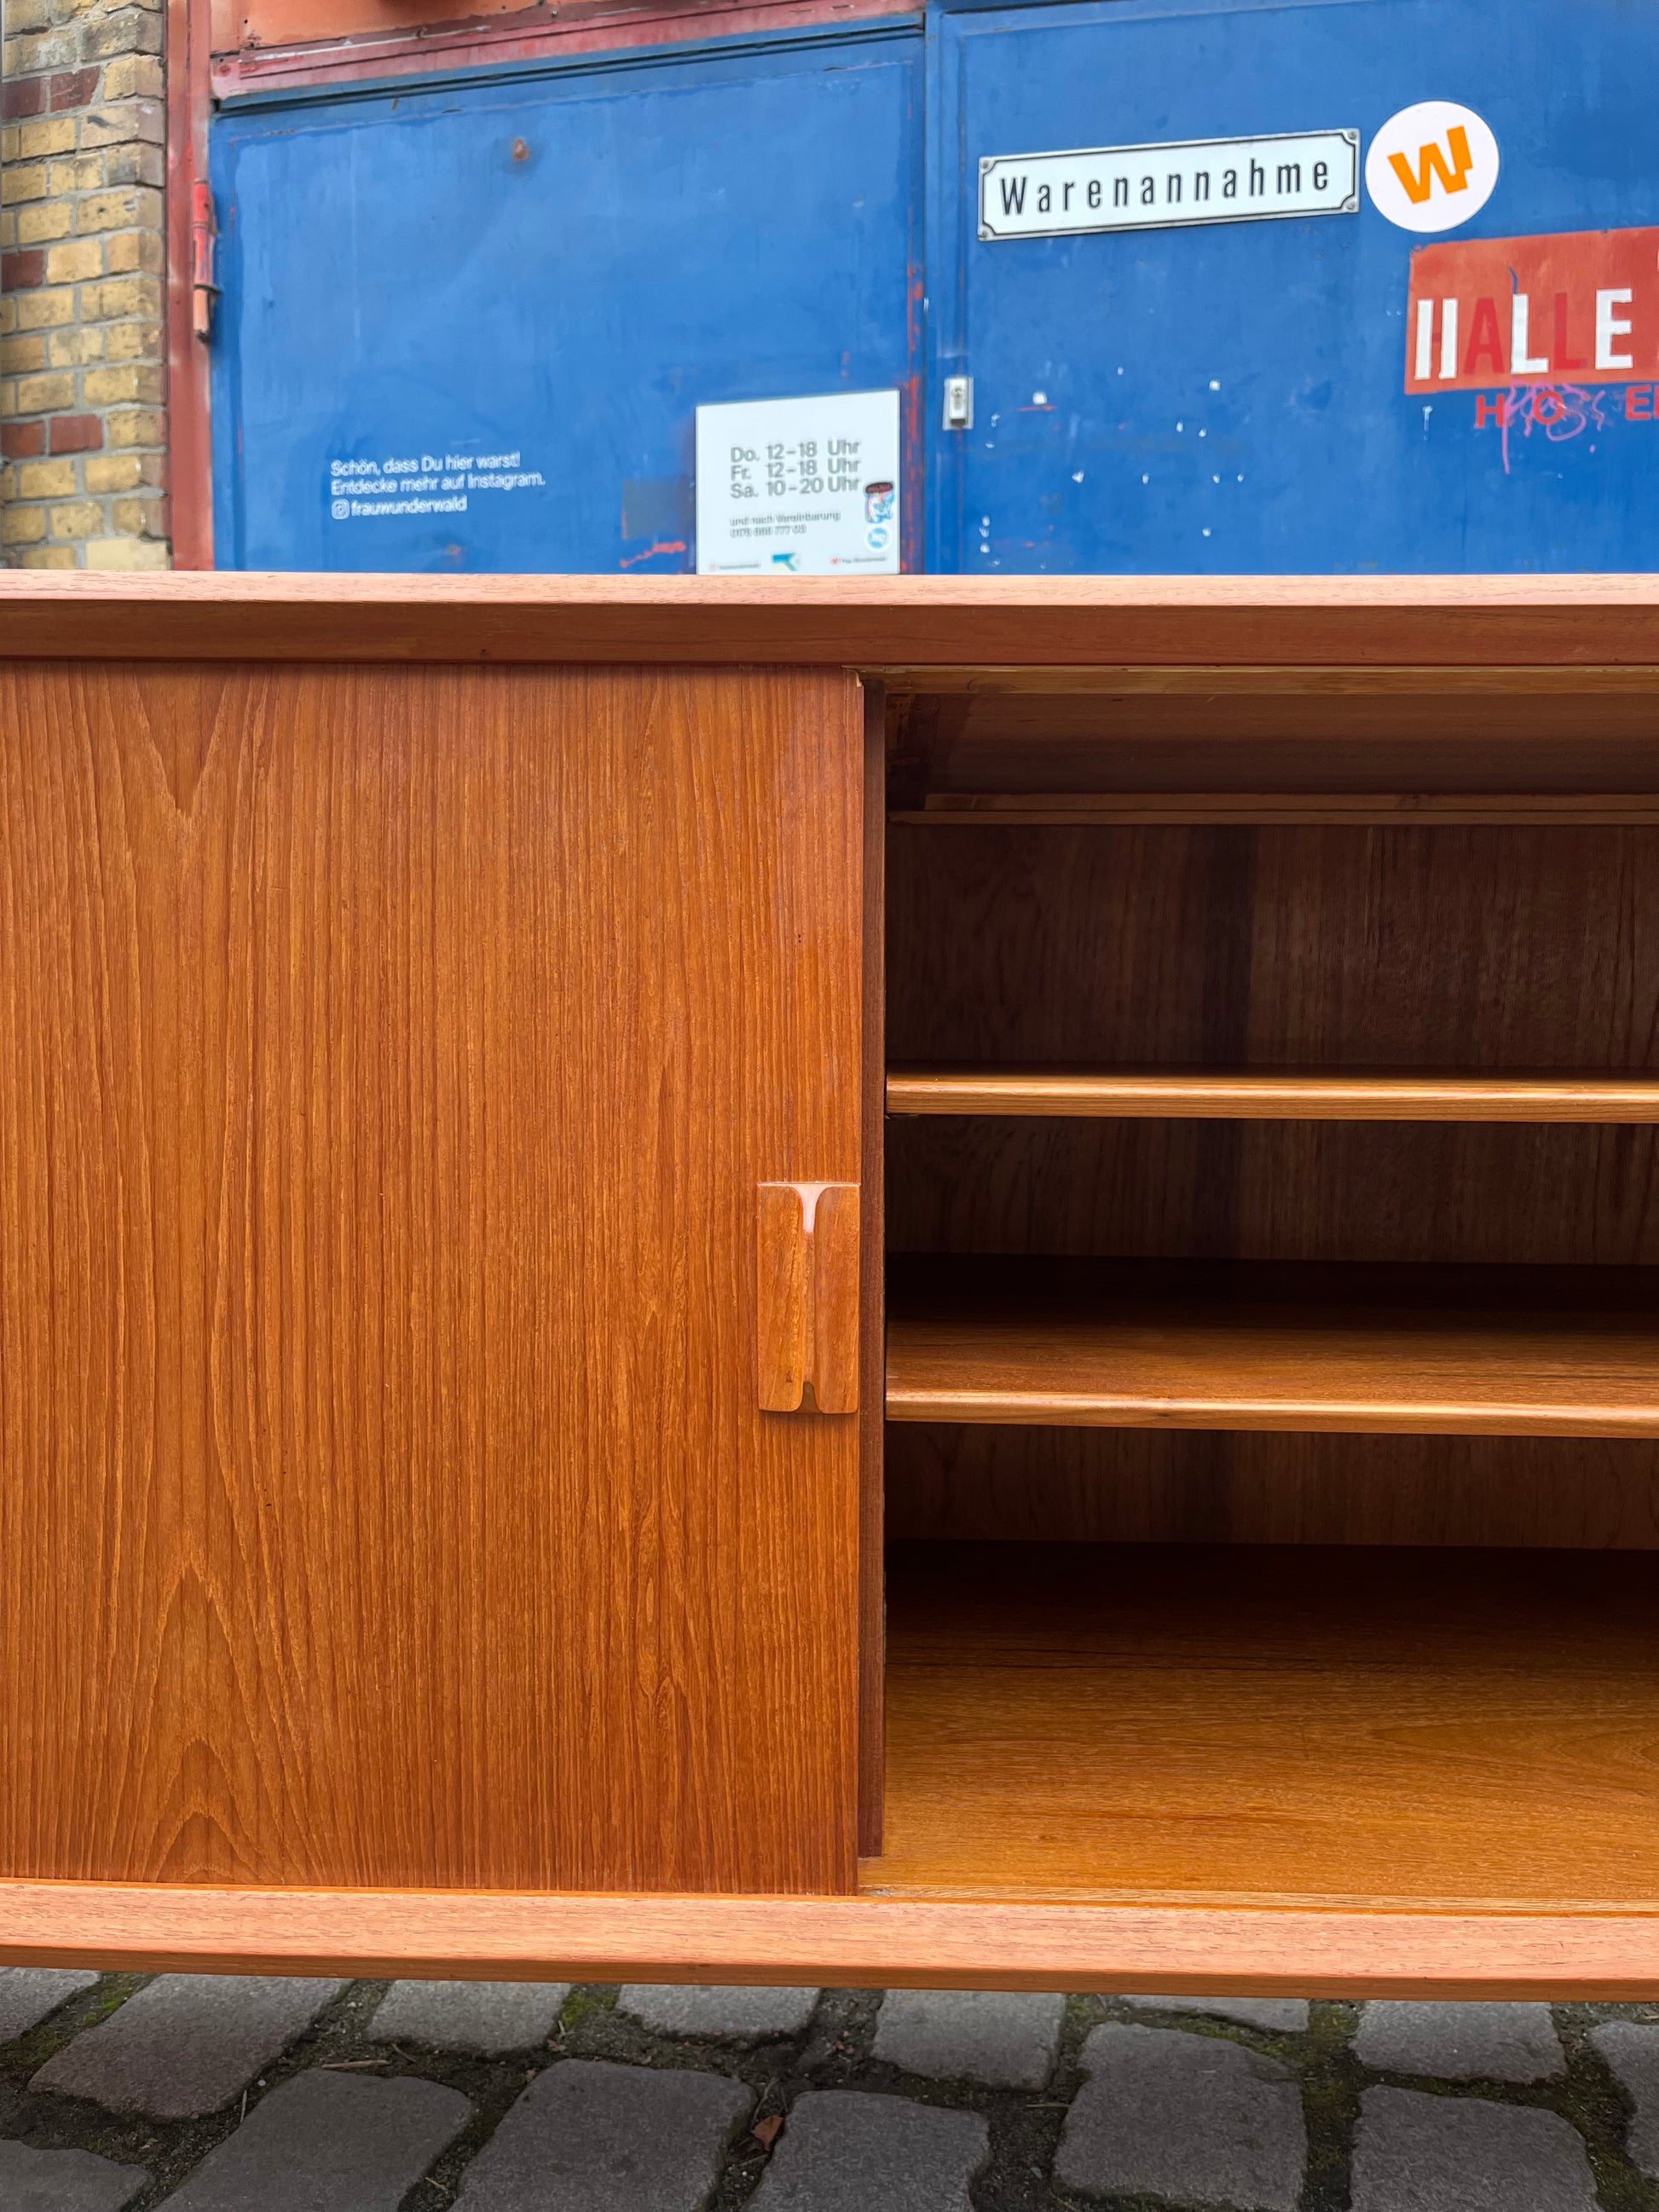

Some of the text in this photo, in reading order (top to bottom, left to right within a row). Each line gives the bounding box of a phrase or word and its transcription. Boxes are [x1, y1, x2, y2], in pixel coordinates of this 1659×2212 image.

[999, 158, 1330, 217] Warenannahme
[730, 446, 760, 463] Do.
[827, 438, 862, 456] Uhr
[330, 451, 521, 477] Schön, dass Du hier warst!
[730, 465, 751, 482] Fr.
[827, 457, 862, 475] Uhr
[330, 471, 546, 496] Entdecke mehr auf Instagram.
[730, 482, 759, 499] Sa.
[827, 476, 862, 494] Uhr
[350, 494, 468, 517] frauwunderwald
